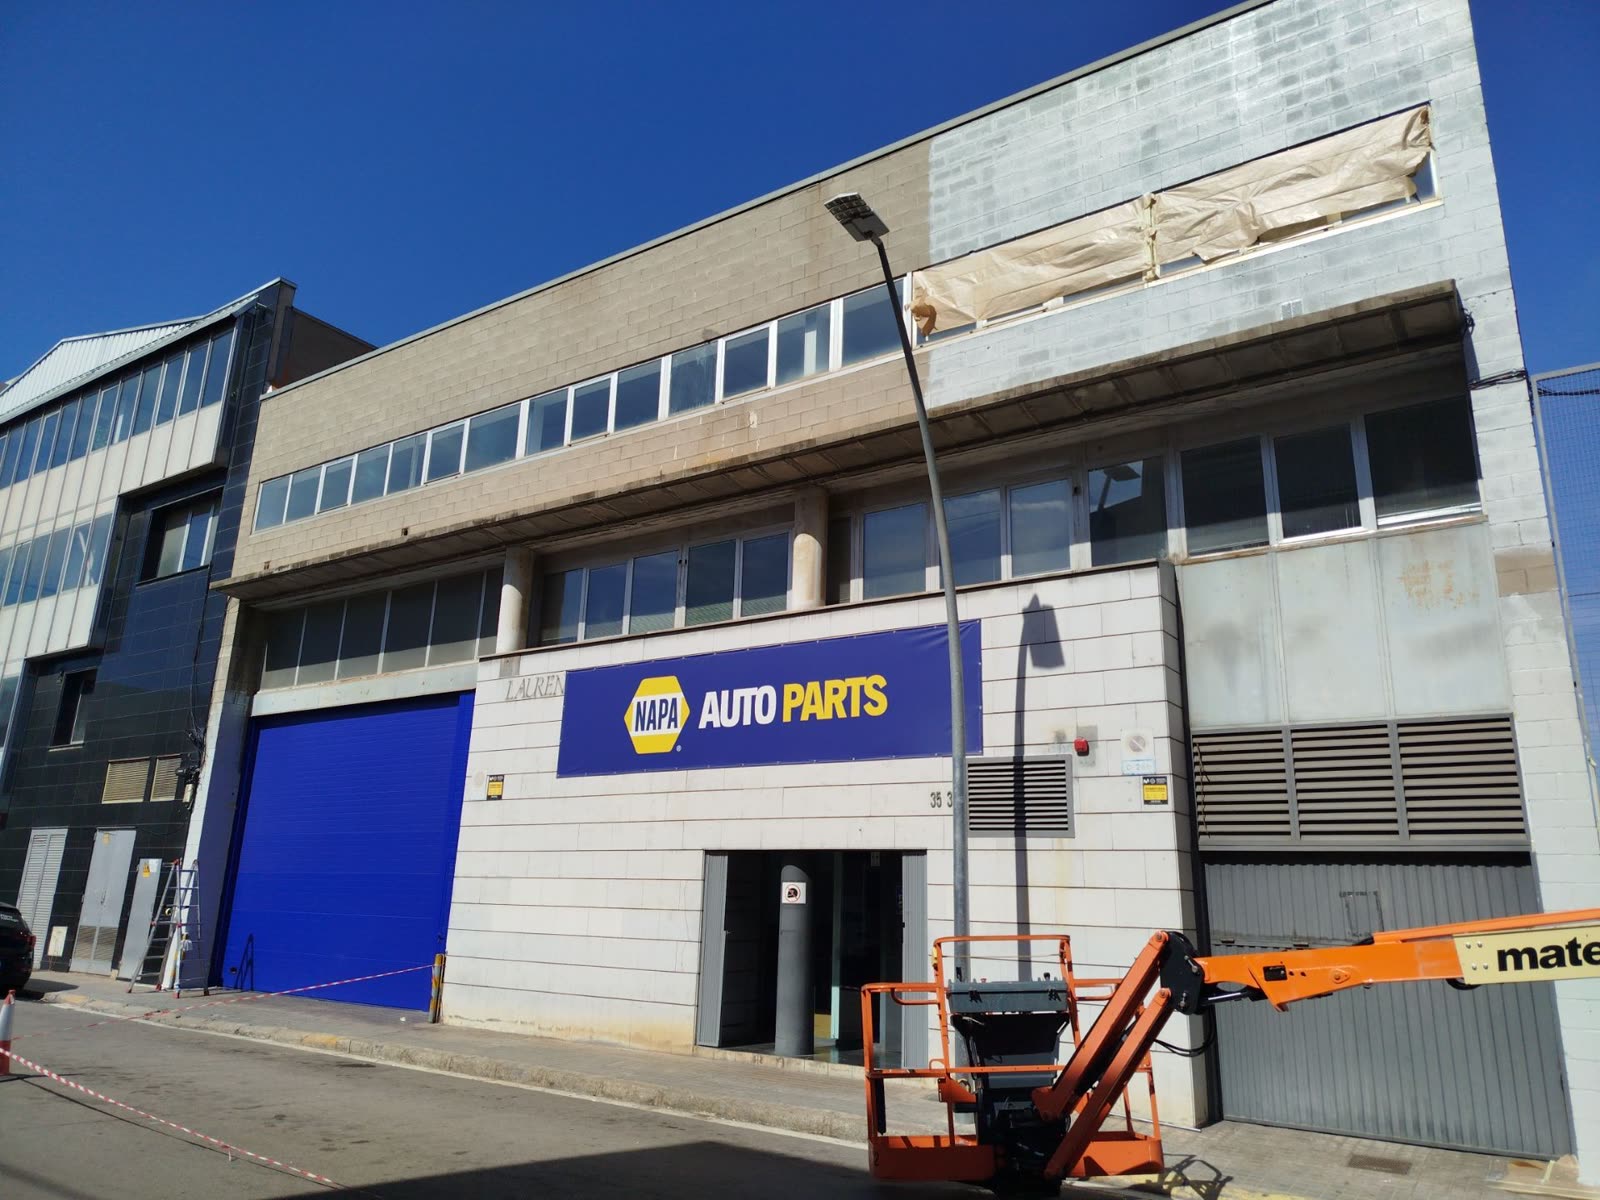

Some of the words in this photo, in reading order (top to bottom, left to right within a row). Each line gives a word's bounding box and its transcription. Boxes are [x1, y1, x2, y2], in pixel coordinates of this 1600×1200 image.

[635, 697, 678, 732] NAPA
[698, 685, 777, 729] AUTO
[782, 674, 888, 723] PARTS
[930, 791, 942, 808] 35
[1497, 936, 1600, 972] mate
